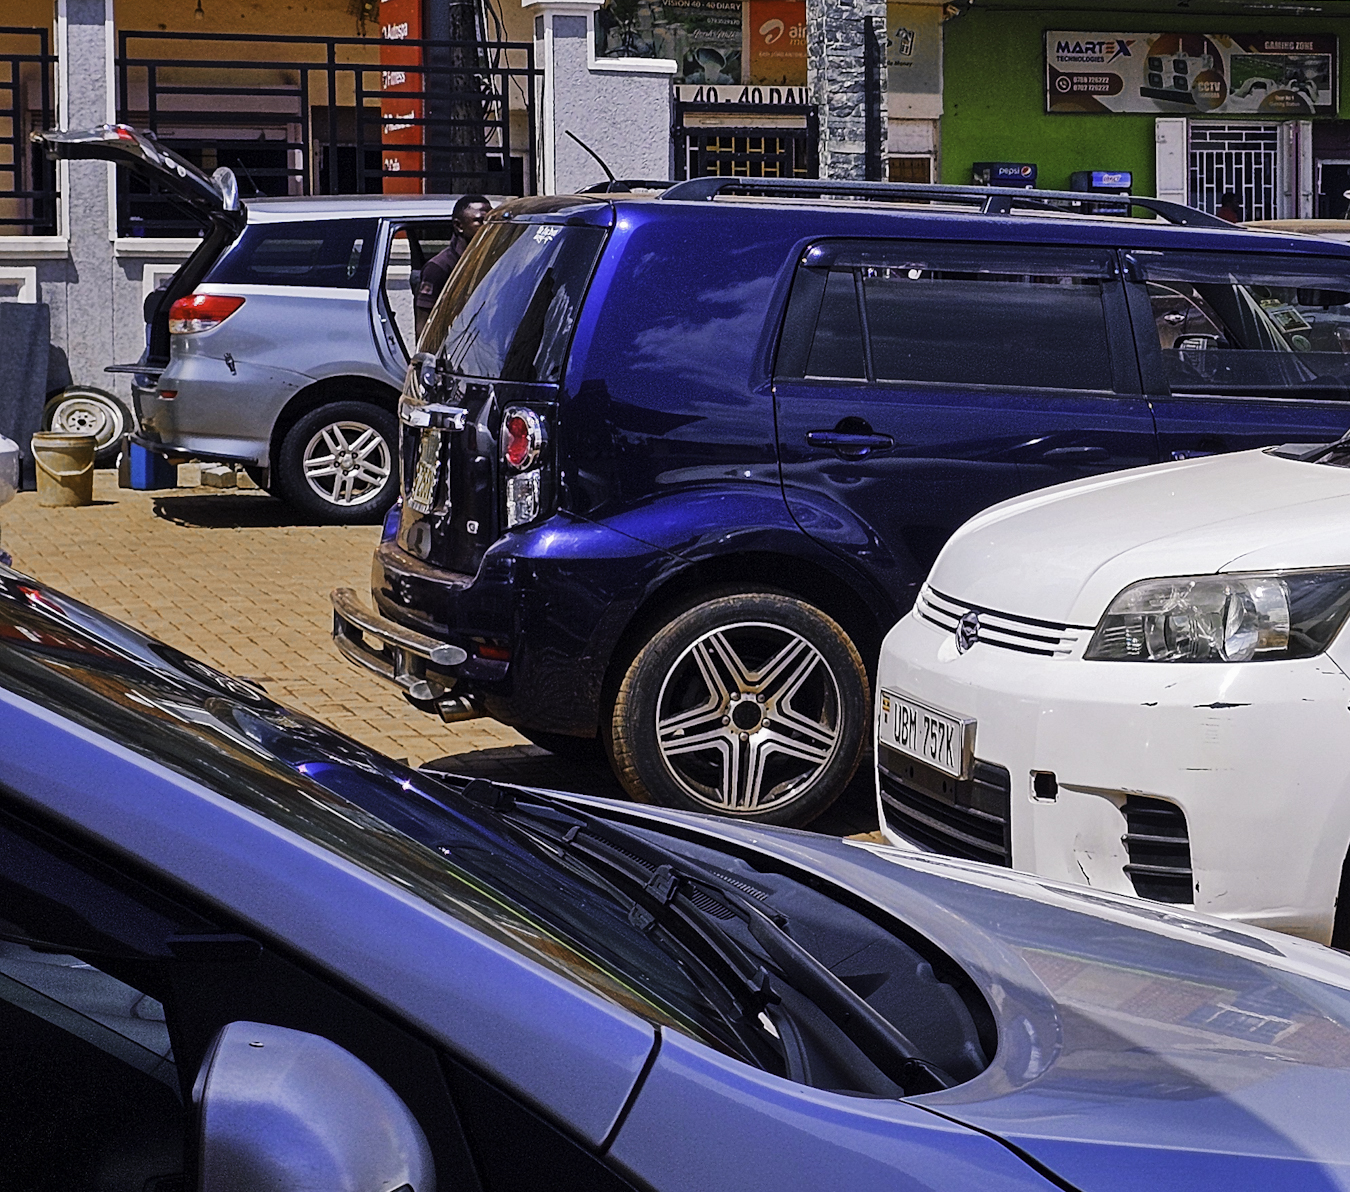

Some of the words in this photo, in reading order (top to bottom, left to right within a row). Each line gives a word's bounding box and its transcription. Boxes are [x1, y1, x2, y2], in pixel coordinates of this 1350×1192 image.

[788, 22, 808, 38] air
[1056, 40, 1136, 63] MARTEX
[1264, 41, 1295, 50] GAMING
[1295, 42, 1314, 50] ZONE
[1197, 81, 1221, 92] CCTV
[768, 87, 810, 104] DAI
[998, 167, 1020, 175] pepsi
[894, 702, 918, 752] UBM
[923, 714, 955, 768] 757K
